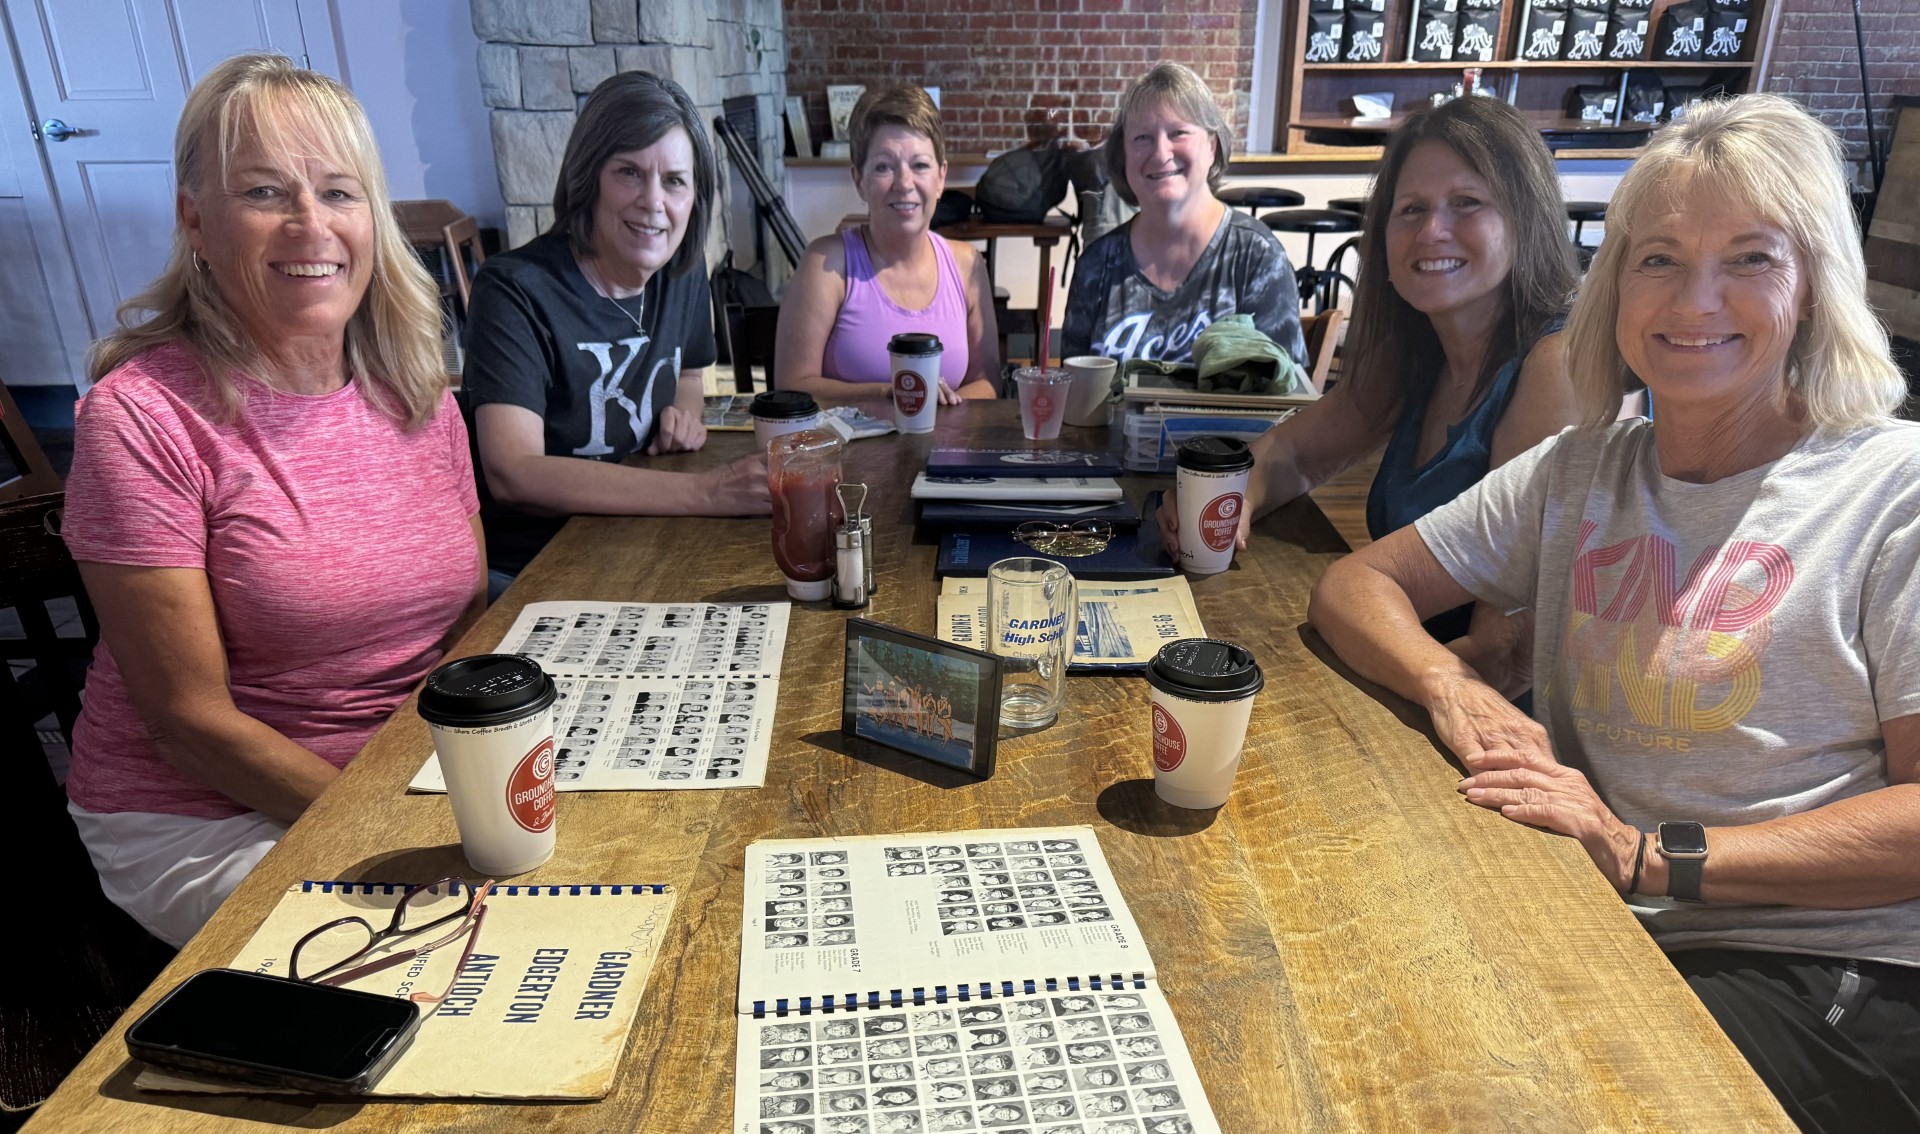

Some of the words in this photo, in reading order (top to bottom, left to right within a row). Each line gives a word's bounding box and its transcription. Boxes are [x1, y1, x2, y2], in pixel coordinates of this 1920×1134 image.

[1214, 526, 1232, 537] COFFEE
[951, 614, 972, 642] GARDNER
[1004, 632, 1035, 646] High
[472, 728, 492, 736] Coffee
[493, 725, 512, 733] Breath
[1594, 723, 1692, 753] FUTURE
[534, 786, 554, 811] COFFEE
[1110, 924, 1127, 944] GRADE
[255, 957, 277, 973] 196
[406, 949, 433, 978] NIFIED
[849, 948, 860, 968] GRADE
[394, 981, 413, 999] SCH
[436, 953, 501, 1016] ANTIOCH
[502, 948, 569, 1023] EDGERTON
[573, 951, 633, 1020] GARDNER
